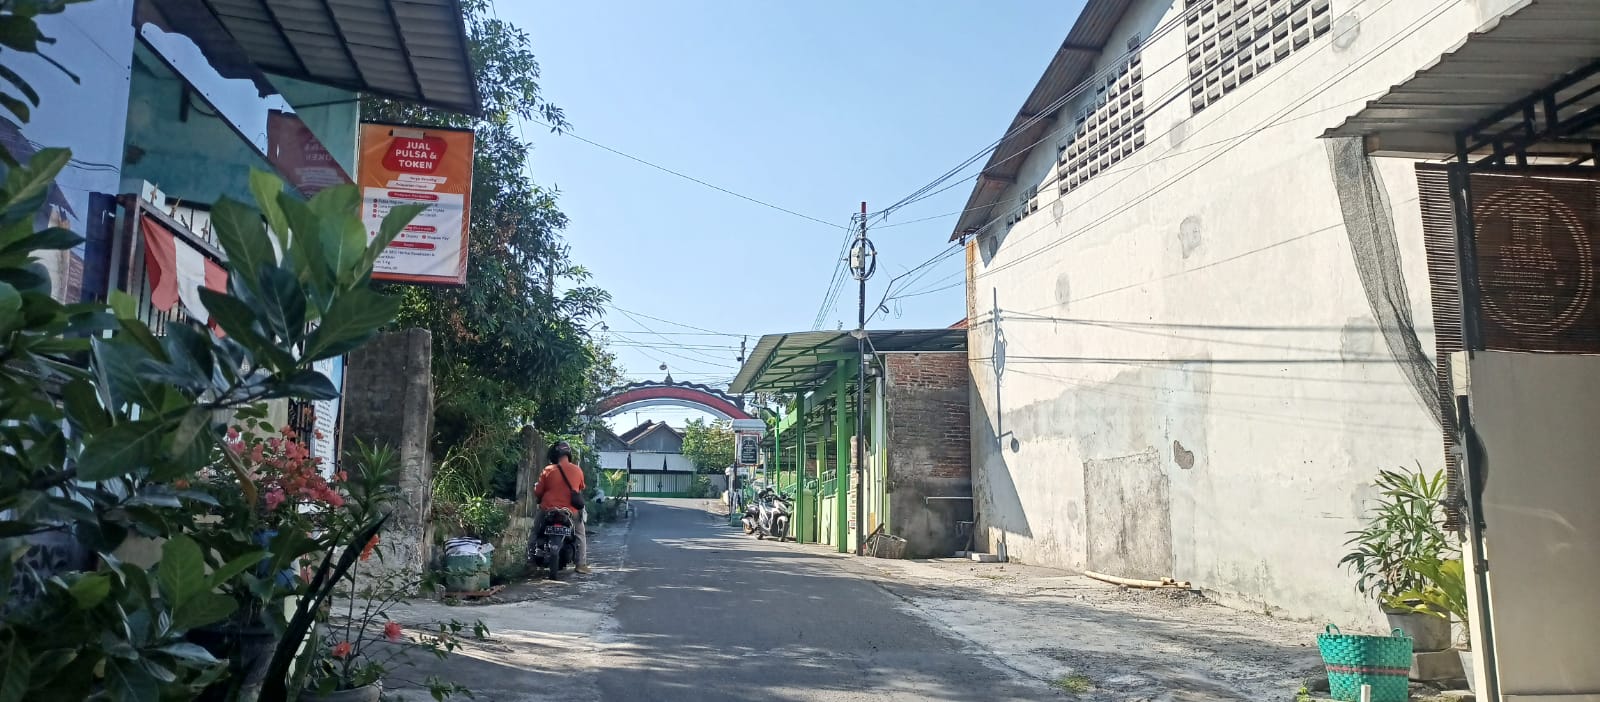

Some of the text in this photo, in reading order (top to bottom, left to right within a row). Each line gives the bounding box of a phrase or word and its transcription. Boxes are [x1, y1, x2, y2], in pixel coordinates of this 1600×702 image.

[406, 141, 431, 151] JUAL
[395, 149, 427, 159] PULSA
[398, 159, 433, 169] TOKEN
